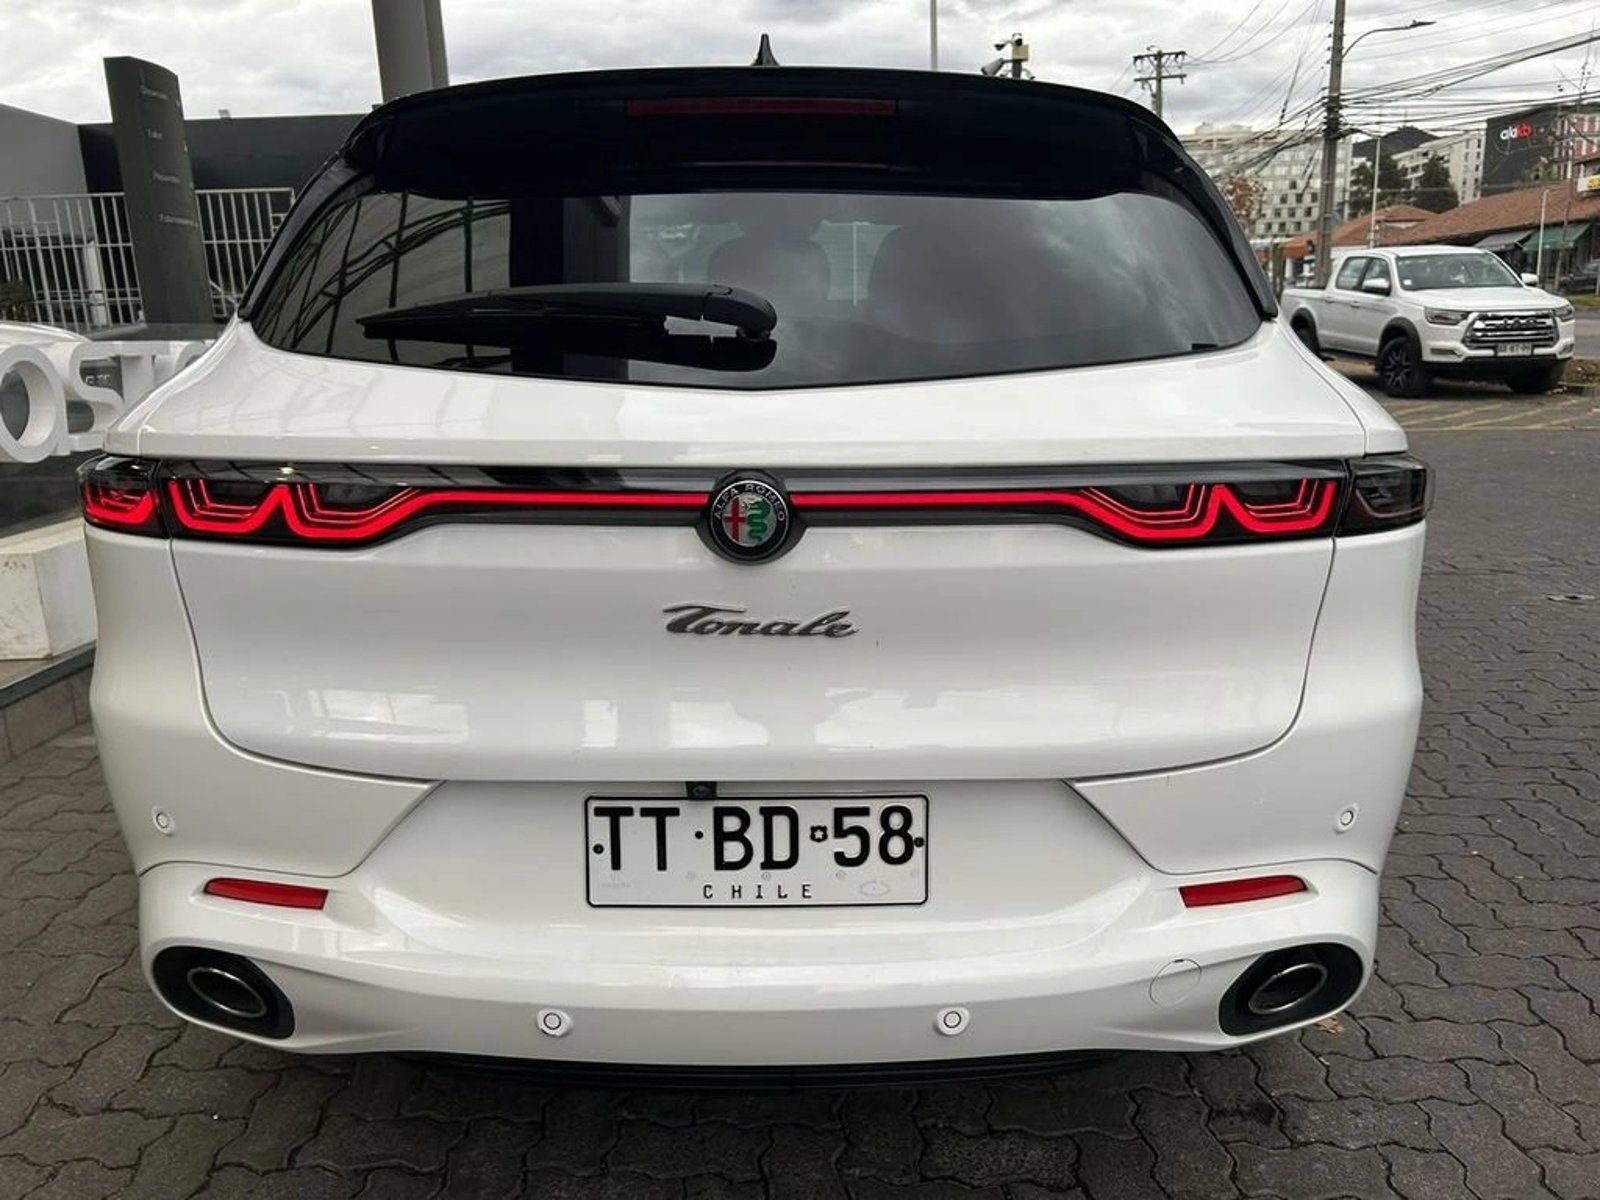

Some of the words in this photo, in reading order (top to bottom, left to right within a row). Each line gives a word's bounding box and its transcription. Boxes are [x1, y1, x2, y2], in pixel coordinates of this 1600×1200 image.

[714, 487, 739, 520] ALFA
[744, 483, 785, 521] ROMEO
[662, 604, 859, 637] Tonale
[703, 884, 813, 900] CHILE
